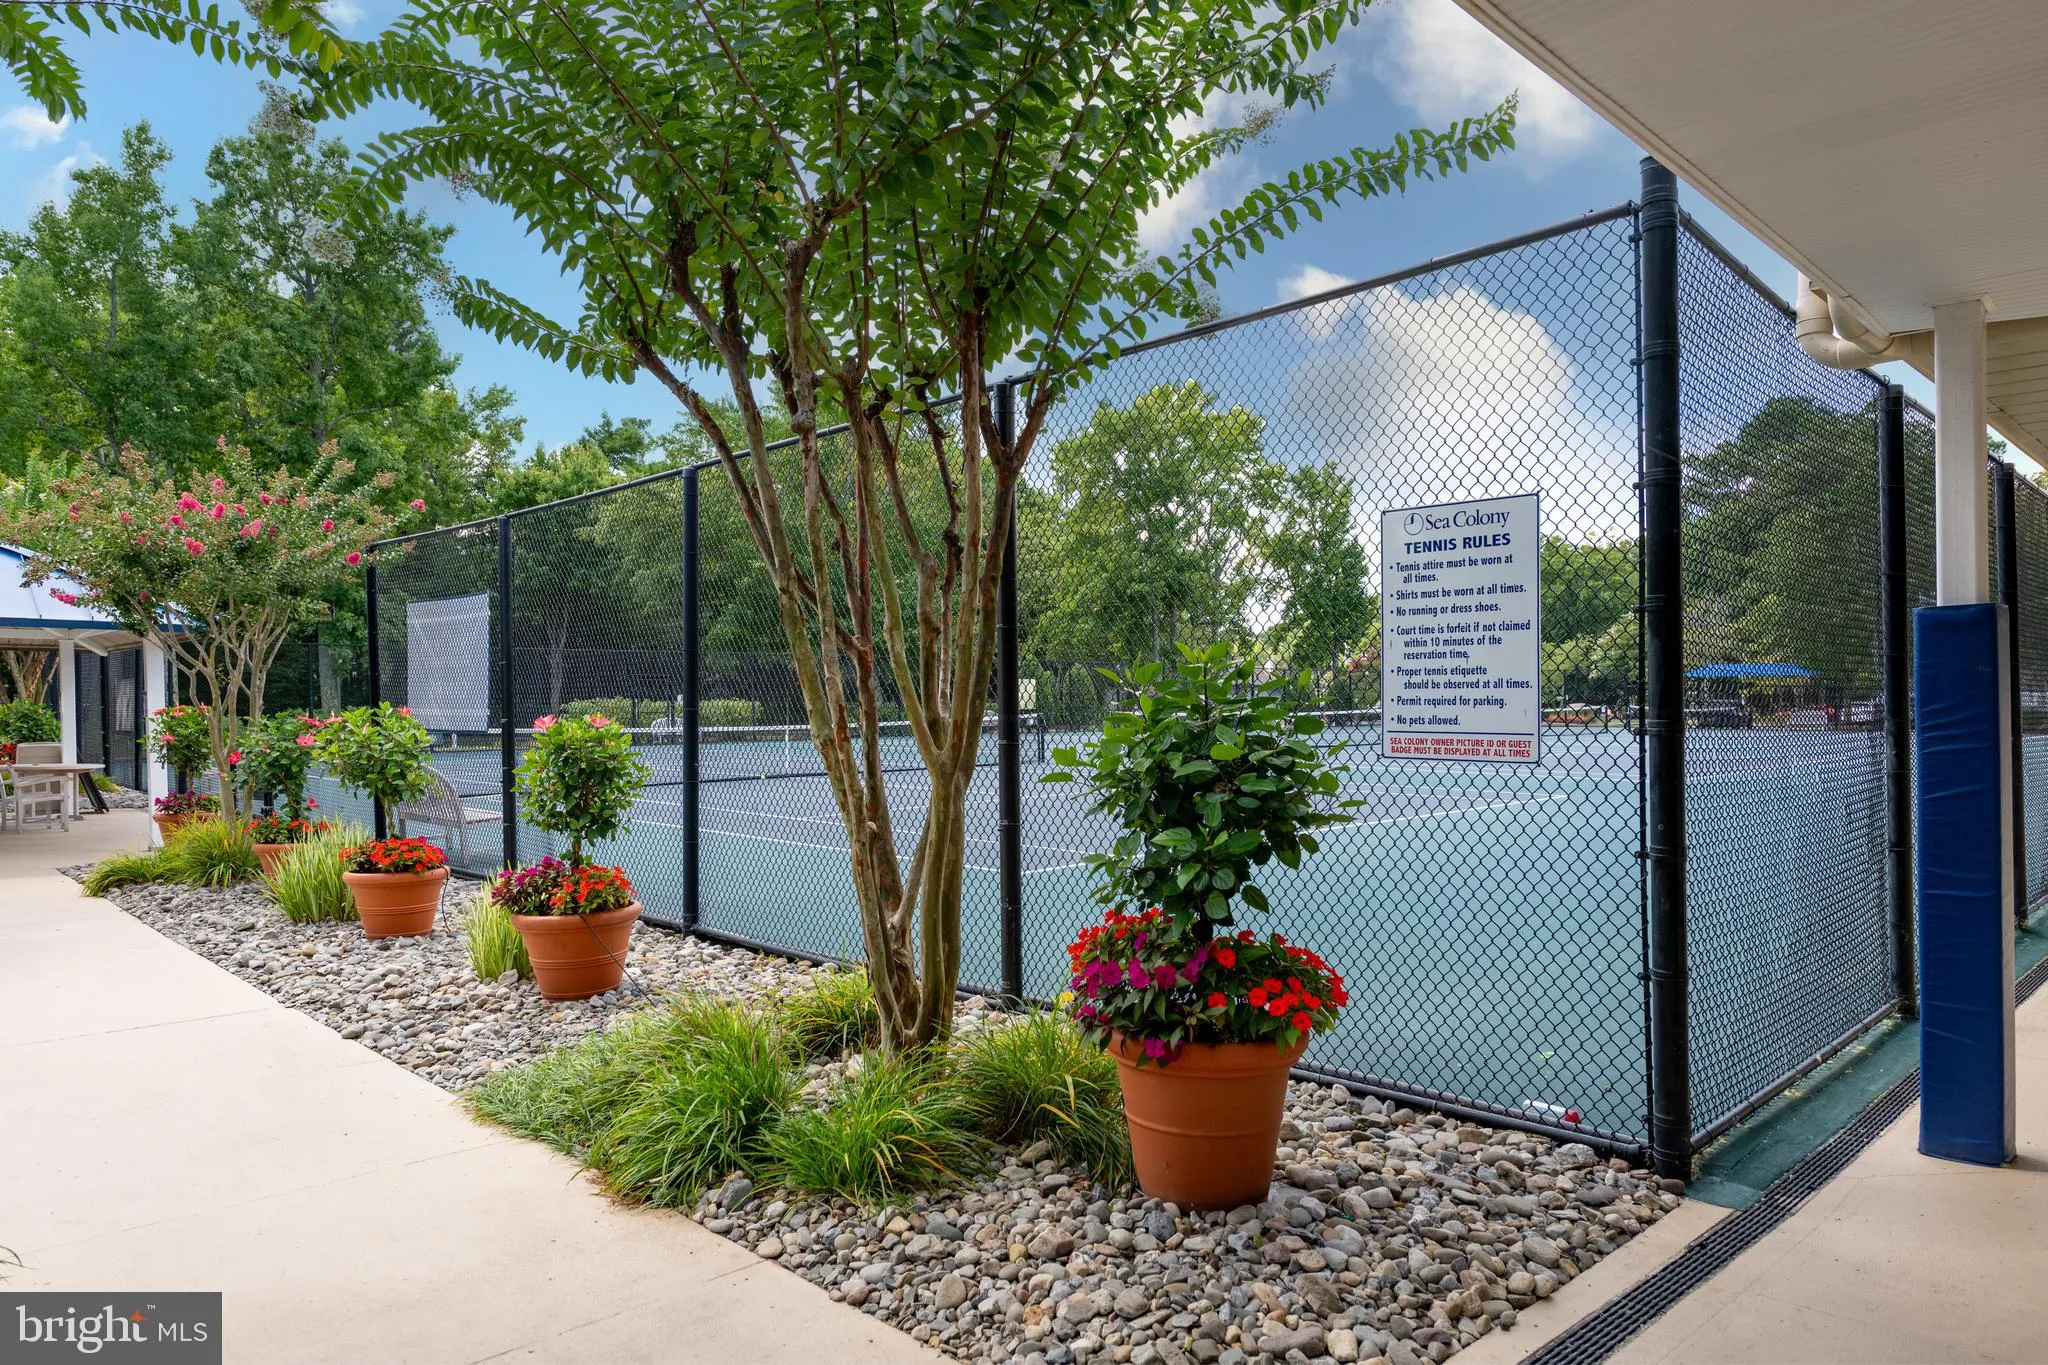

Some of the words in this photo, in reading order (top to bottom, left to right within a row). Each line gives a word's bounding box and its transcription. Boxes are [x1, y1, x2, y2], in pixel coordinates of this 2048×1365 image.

[1426, 514, 1450, 530] Sea
[1453, 510, 1510, 528] Colony
[1404, 538, 1456, 554] TENNIS
[1463, 533, 1510, 549] RULES
[1396, 561, 1420, 572] Tennis
[1423, 560, 1444, 570] attire
[1447, 558, 1467, 568] must
[1469, 556, 1478, 566] be
[1481, 556, 1501, 565] worn
[1505, 554, 1512, 563] at
[1403, 574, 1412, 583] all
[1415, 573, 1438, 583] times.
[1396, 590, 1418, 600] Shirts
[1421, 588, 1440, 598] must
[1442, 587, 1451, 597] be
[1454, 587, 1474, 596] worn
[1477, 585, 1484, 594] at
[1487, 584, 1497, 594] all
[1500, 583, 1526, 594] times.
[1396, 607, 1406, 616] No
[1409, 606, 1437, 617] running
[1440, 604, 1448, 614] or
[1451, 604, 1472, 613] dress
[1475, 602, 1501, 612] shoes.
[1396, 625, 1416, 635] Court
[1419, 624, 1435, 634] time
[1438, 624, 1444, 633] is
[1447, 623, 1471, 633] forfeit
[1474, 622, 1479, 632] if
[1482, 622, 1496, 631] not
[1499, 620, 1530, 631] claimed
[1404, 638, 1427, 648] within
[1431, 637, 1440, 647] 10
[1443, 636, 1474, 646] minutes
[1477, 635, 1486, 645] of
[1489, 635, 1502, 644] the
[1404, 649, 1447, 660] reservation
[1397, 667, 1421, 678] Proper
[1424, 666, 1447, 675] tennis
[1450, 666, 1487, 678] etiquette
[1404, 680, 1428, 690] should
[1432, 679, 1441, 689] be
[1444, 679, 1479, 688] observed
[1483, 679, 1490, 688] at
[1493, 678, 1503, 688] all
[1506, 678, 1532, 688] times.
[1397, 696, 1421, 706] Permit
[1424, 696, 1456, 707] required
[1460, 696, 1470, 705] for
[1474, 696, 1507, 708] parking.
[1397, 715, 1406, 724] No
[1409, 716, 1425, 726] pets
[1428, 715, 1460, 725] allowed.
[1391, 745, 1411, 754] BADGE
[1456, 739, 1484, 747] PICTURE
[1508, 740, 1531, 748] GUEST
